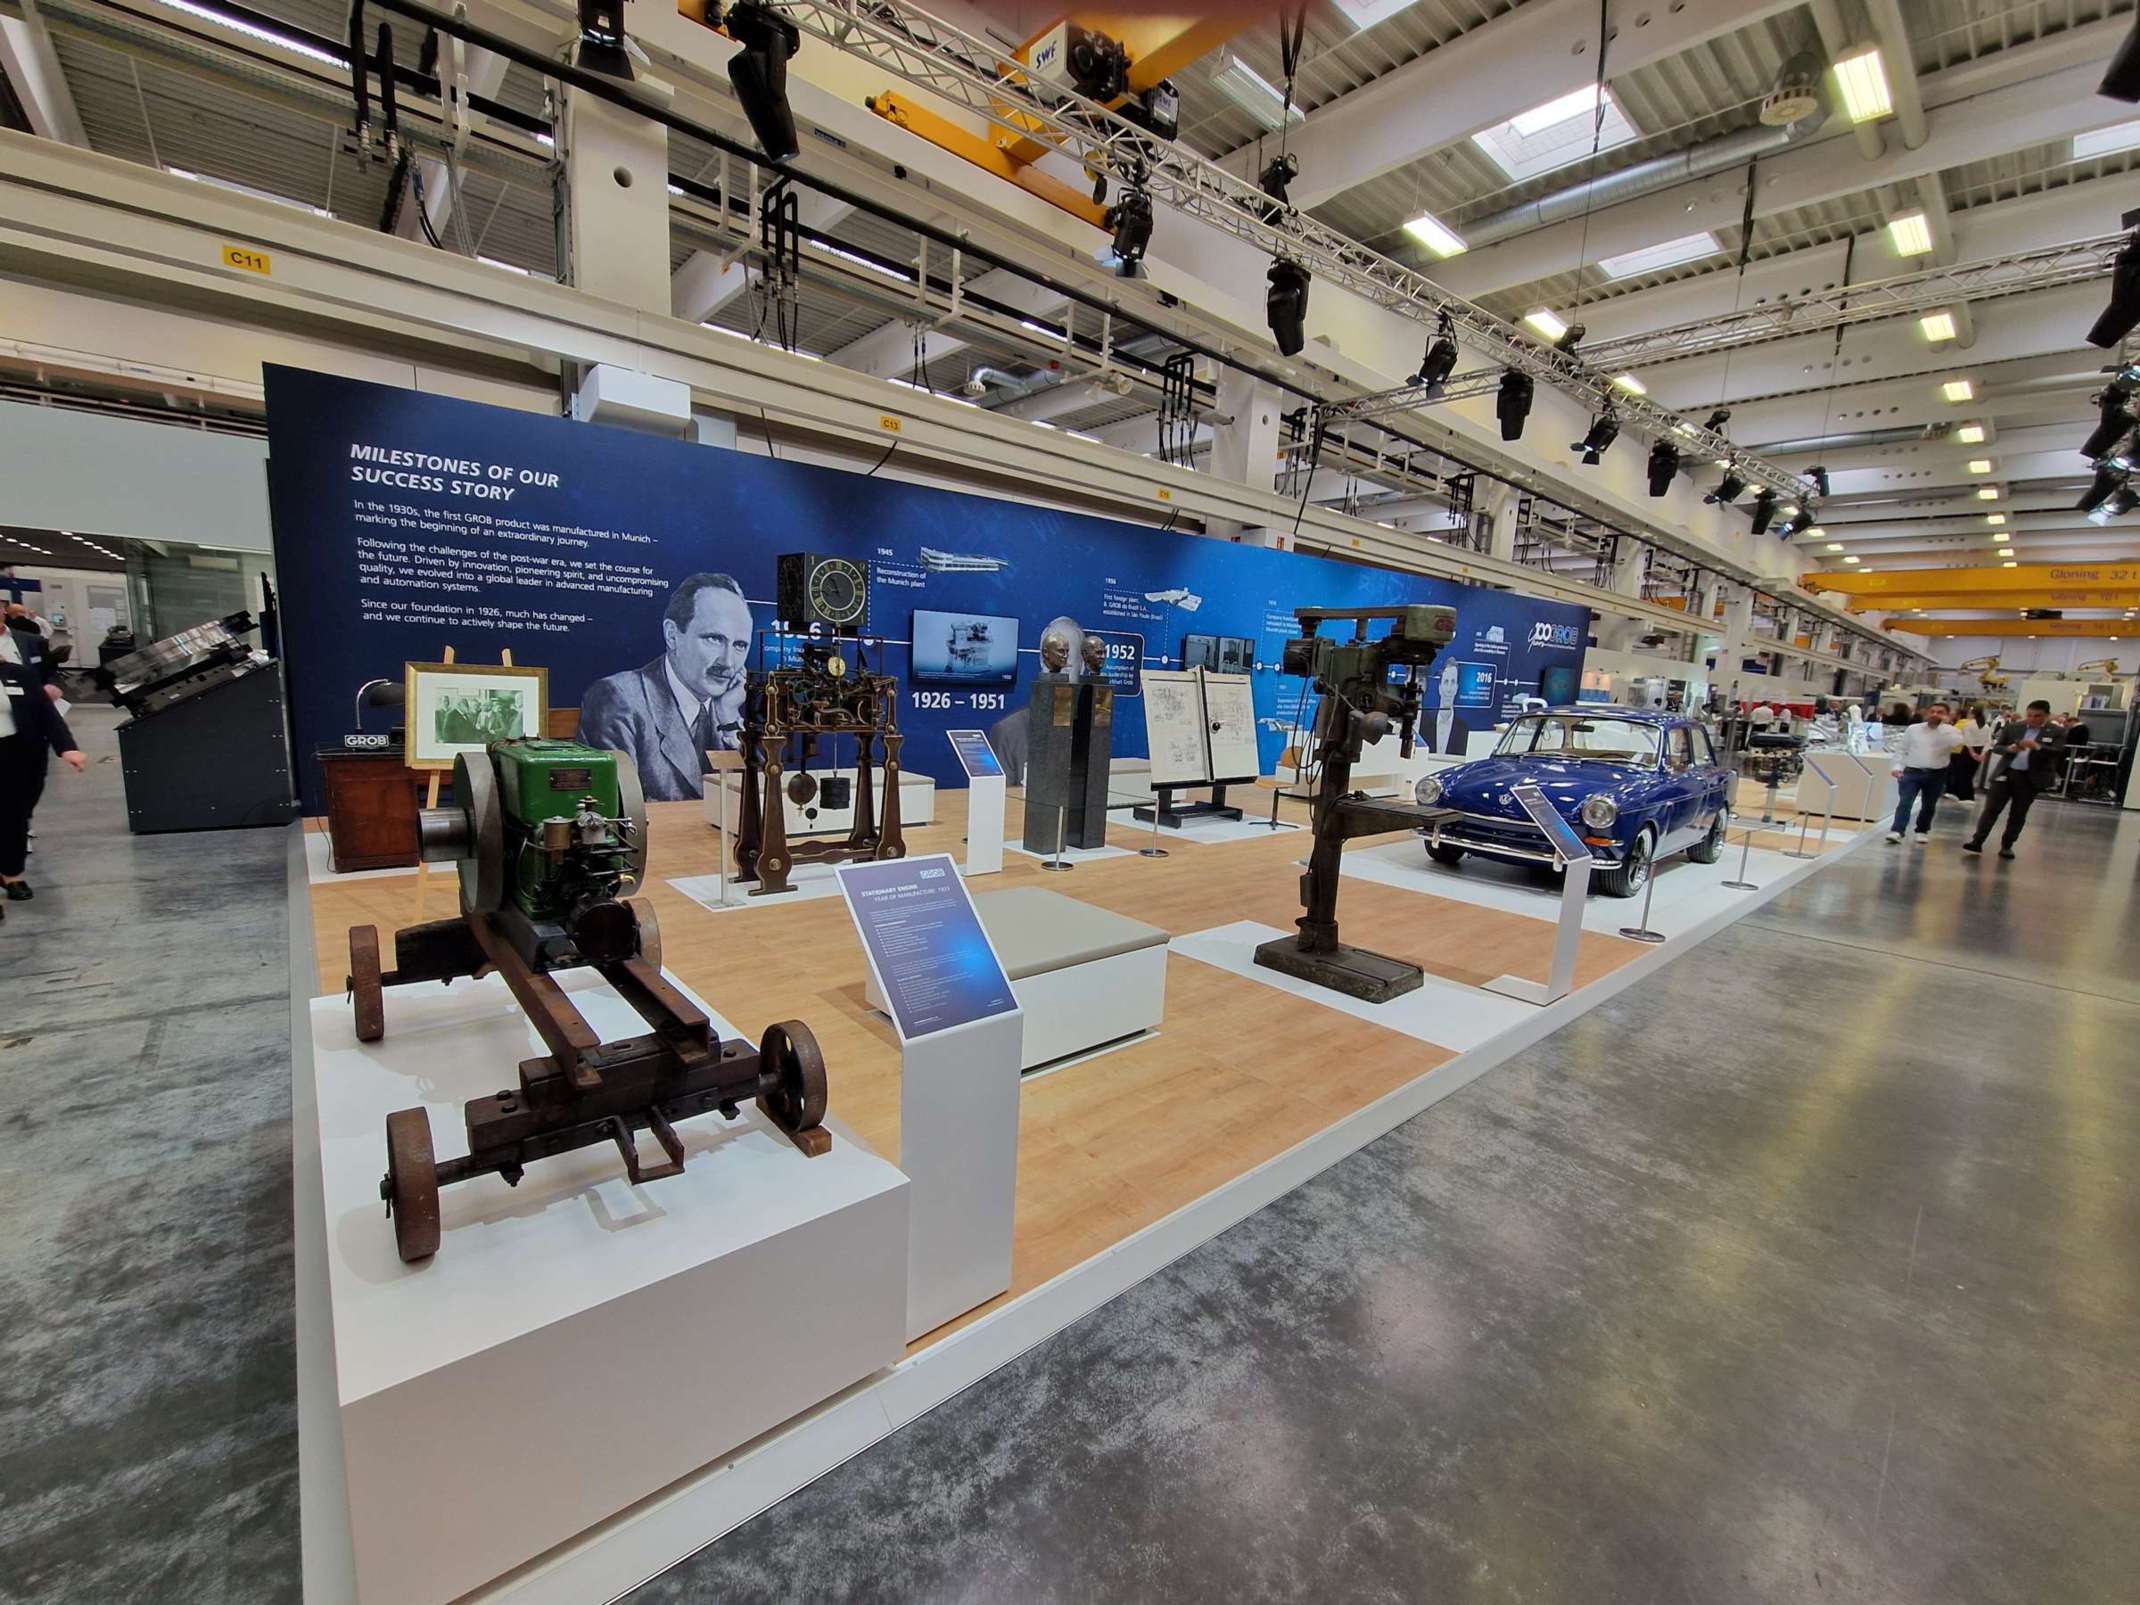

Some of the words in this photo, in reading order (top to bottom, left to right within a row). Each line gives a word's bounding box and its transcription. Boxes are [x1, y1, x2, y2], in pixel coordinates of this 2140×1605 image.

[1036, 41, 1057, 69] SWF
[231, 252, 262, 269] C11
[350, 444, 481, 477] MILESTONES
[488, 465, 513, 480] OF
[519, 469, 559, 488] OUR
[351, 466, 444, 492] SUCCESS
[450, 481, 515, 501] STORY
[354, 500, 364, 509] In
[367, 501, 385, 512] the
[389, 504, 421, 517] 1930s,
[424, 508, 440, 519] the
[443, 510, 462, 522] first
[464, 513, 492, 525] GROB
[495, 518, 530, 530] product
[533, 523, 550, 532] was
[552, 526, 610, 539] manufactured
[611, 529, 619, 539] in
[621, 532, 651, 544] Munich
[355, 513, 397, 527] marking
[400, 517, 417, 528] the
[420, 520, 467, 535] beginning
[470, 526, 480, 535] of
[483, 528, 495, 537] an
[498, 529, 555, 545] extraordinary
[557, 537, 590, 549] journey.
[357, 537, 406, 553] Following
[409, 542, 426, 553] the
[428, 544, 478, 559] challenges
[480, 550, 490, 559] of
[493, 551, 507, 561] the
[510, 553, 549, 565] post-war
[551, 559, 567, 568] era,
[569, 561, 582, 569] we
[585, 562, 597, 570] set
[599, 562, 613, 572] the
[615, 565, 640, 575] course
[642, 566, 653, 575] for
[357, 549, 375, 560] the
[378, 551, 411, 563] future.
[414, 555, 445, 567] Driven
[448, 557, 459, 570] by
[462, 559, 512, 574] innovation,
[515, 566, 560, 579] pioneering
[563, 570, 585, 580] spirit,
[588, 572, 603, 581] and
[605, 575, 669, 588] uncompromising
[359, 562, 396, 575] quality,
[398, 567, 414, 575] we
[417, 567, 453, 579] evolved
[456, 571, 474, 581] into
[486, 573, 513, 584] global
[516, 576, 542, 586] leader
[545, 578, 553, 587] in
[556, 580, 595, 591] advanced
[597, 584, 653, 598] manufacturing
[360, 575, 380, 585] and
[383, 577, 439, 590] automation
[442, 582, 482, 593] systems.
[361, 598, 387, 609] Since
[390, 601, 407, 611] our
[411, 601, 463, 614] foundation
[465, 606, 474, 615] in
[478, 607, 502, 618] 1926,
[505, 609, 530, 619] much
[532, 610, 547, 620] has
[550, 612, 585, 623] changed
[363, 611, 383, 621] and
[386, 614, 400, 622] we
[404, 615, 446, 625] continue
[448, 617, 459, 626] to
[461, 618, 494, 629] actively
[497, 619, 523, 631] shape
[526, 621, 540, 630] the
[542, 622, 570, 632] future.
[1105, 644, 1135, 660] 1952
[1476, 671, 1492, 683] 2016
[911, 691, 951, 709] 1926
[970, 693, 1005, 710] 1951
[346, 735, 388, 746] GROB
